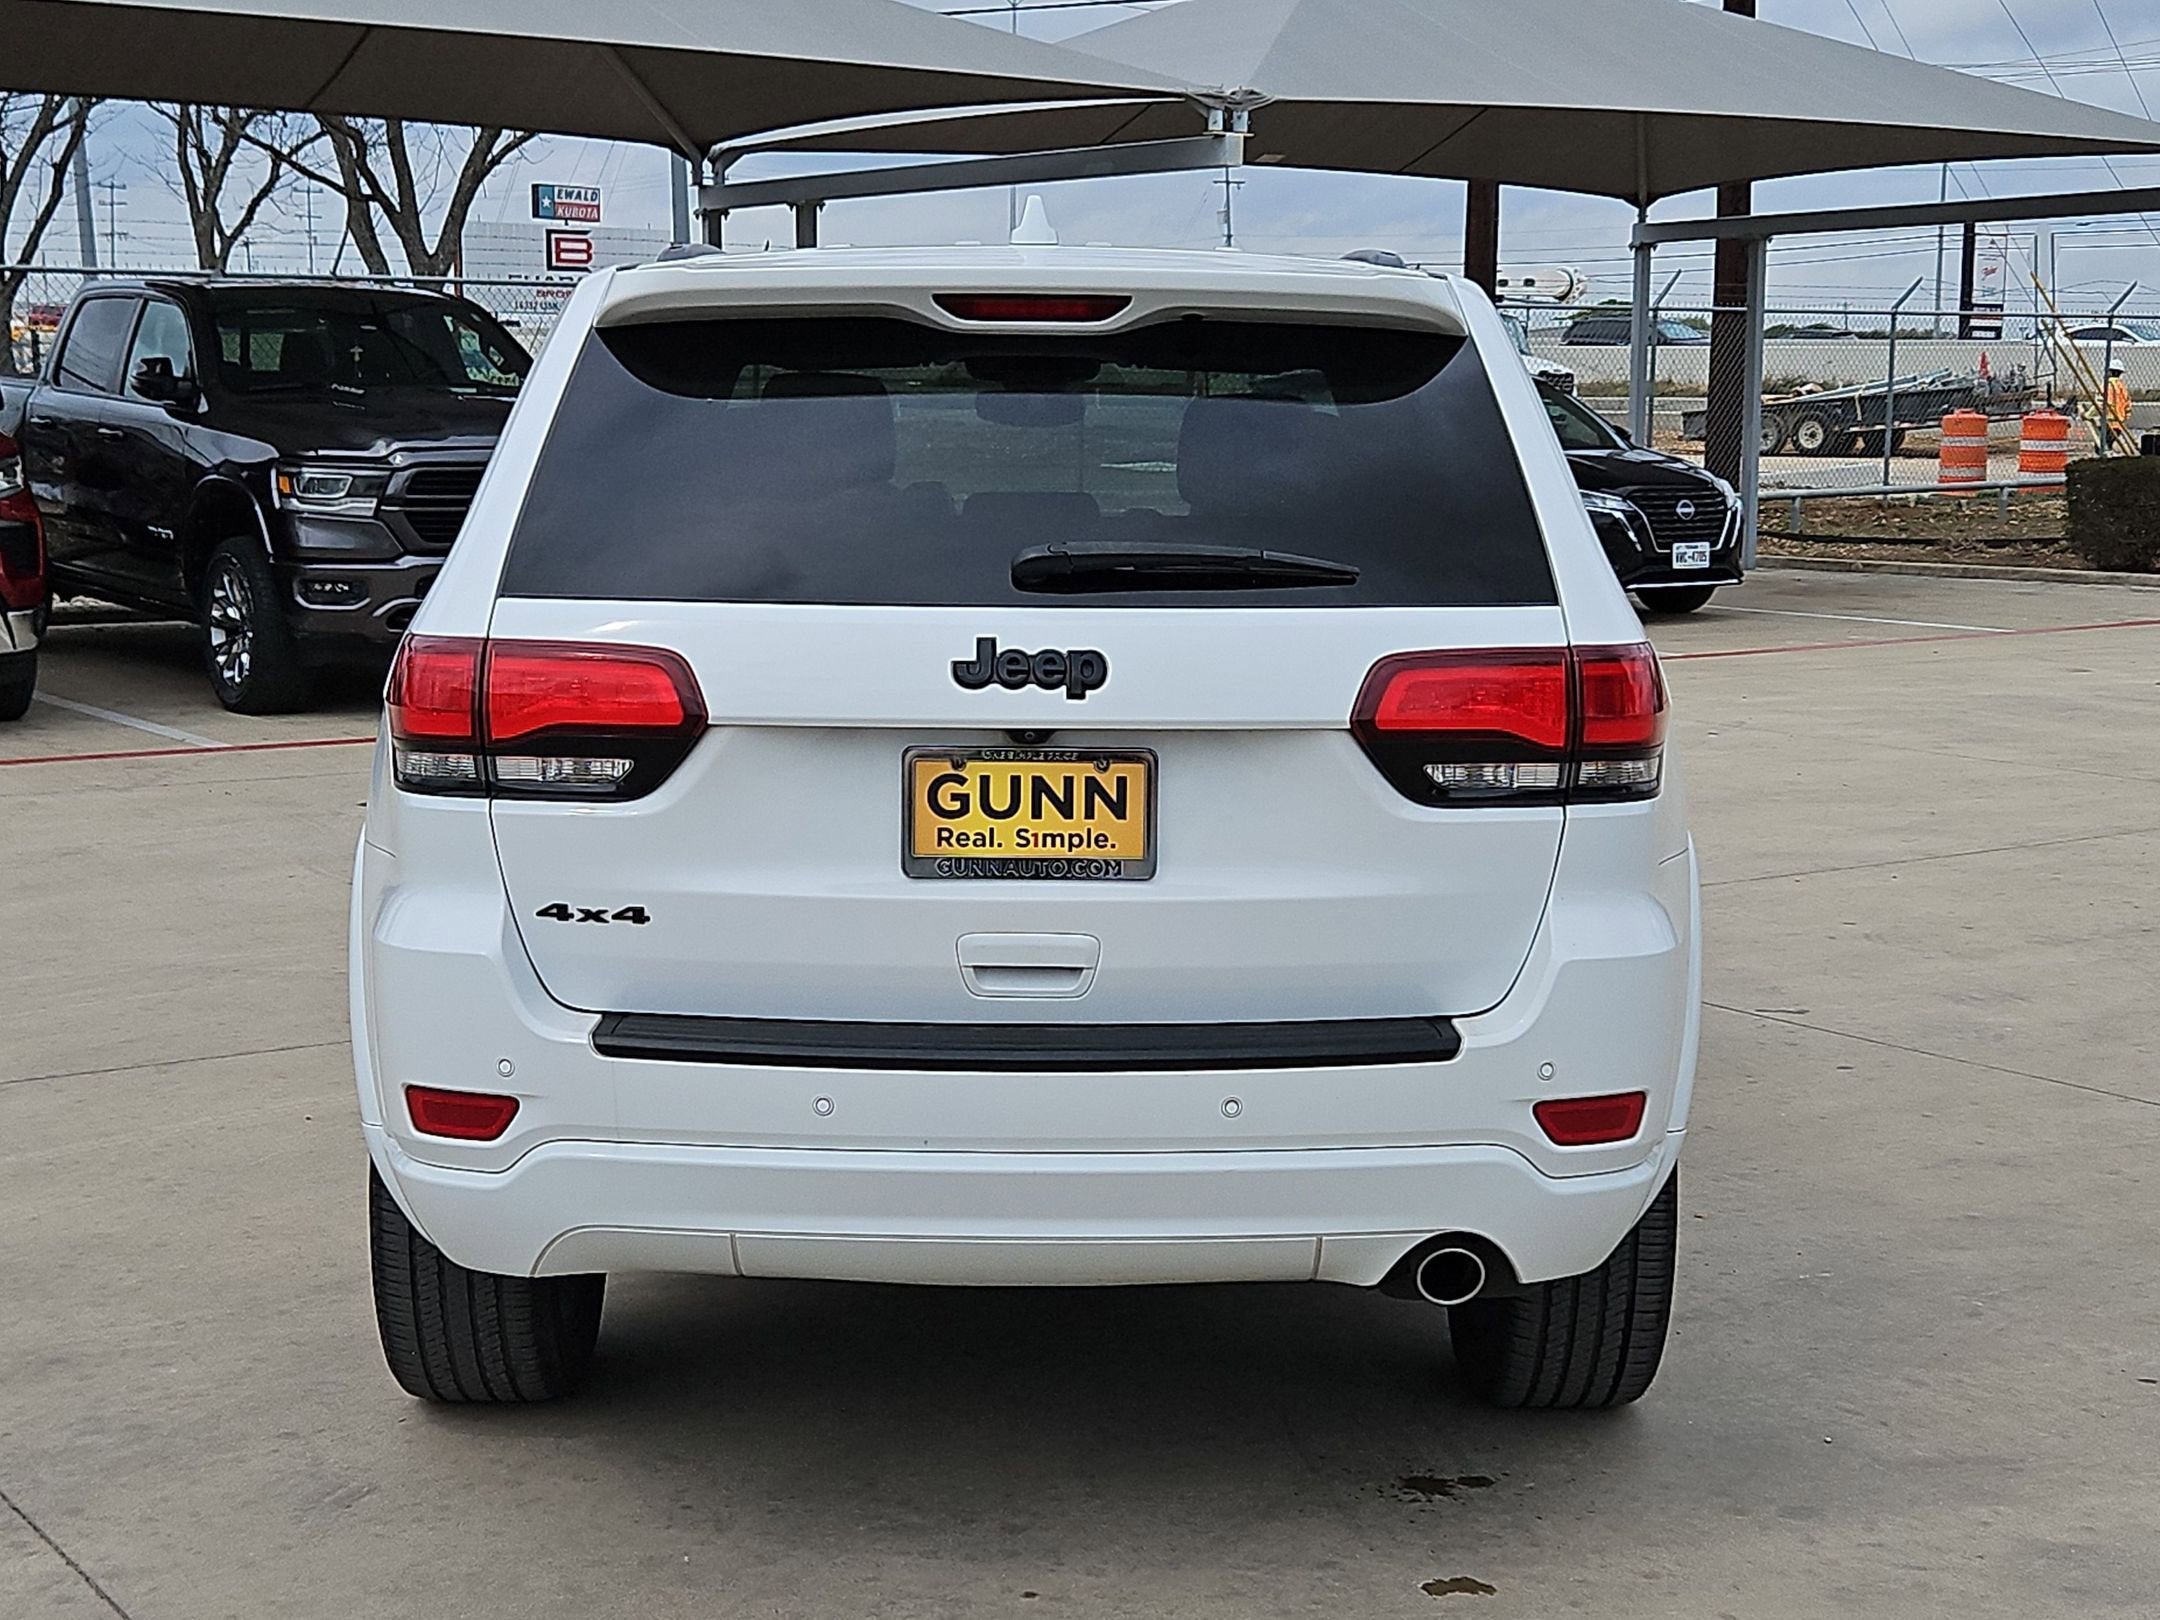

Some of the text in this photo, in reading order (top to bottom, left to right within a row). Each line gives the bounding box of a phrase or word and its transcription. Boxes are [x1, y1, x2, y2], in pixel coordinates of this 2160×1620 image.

[557, 188, 598, 202] EWALD
[556, 205, 598, 219] KUBOTA
[951, 637, 1108, 700] Jeep
[927, 773, 1128, 820] GUNN
[937, 827, 1003, 848] Real.
[934, 858, 1123, 877] GUNNAUTO.COM
[535, 902, 651, 925] 4x4
